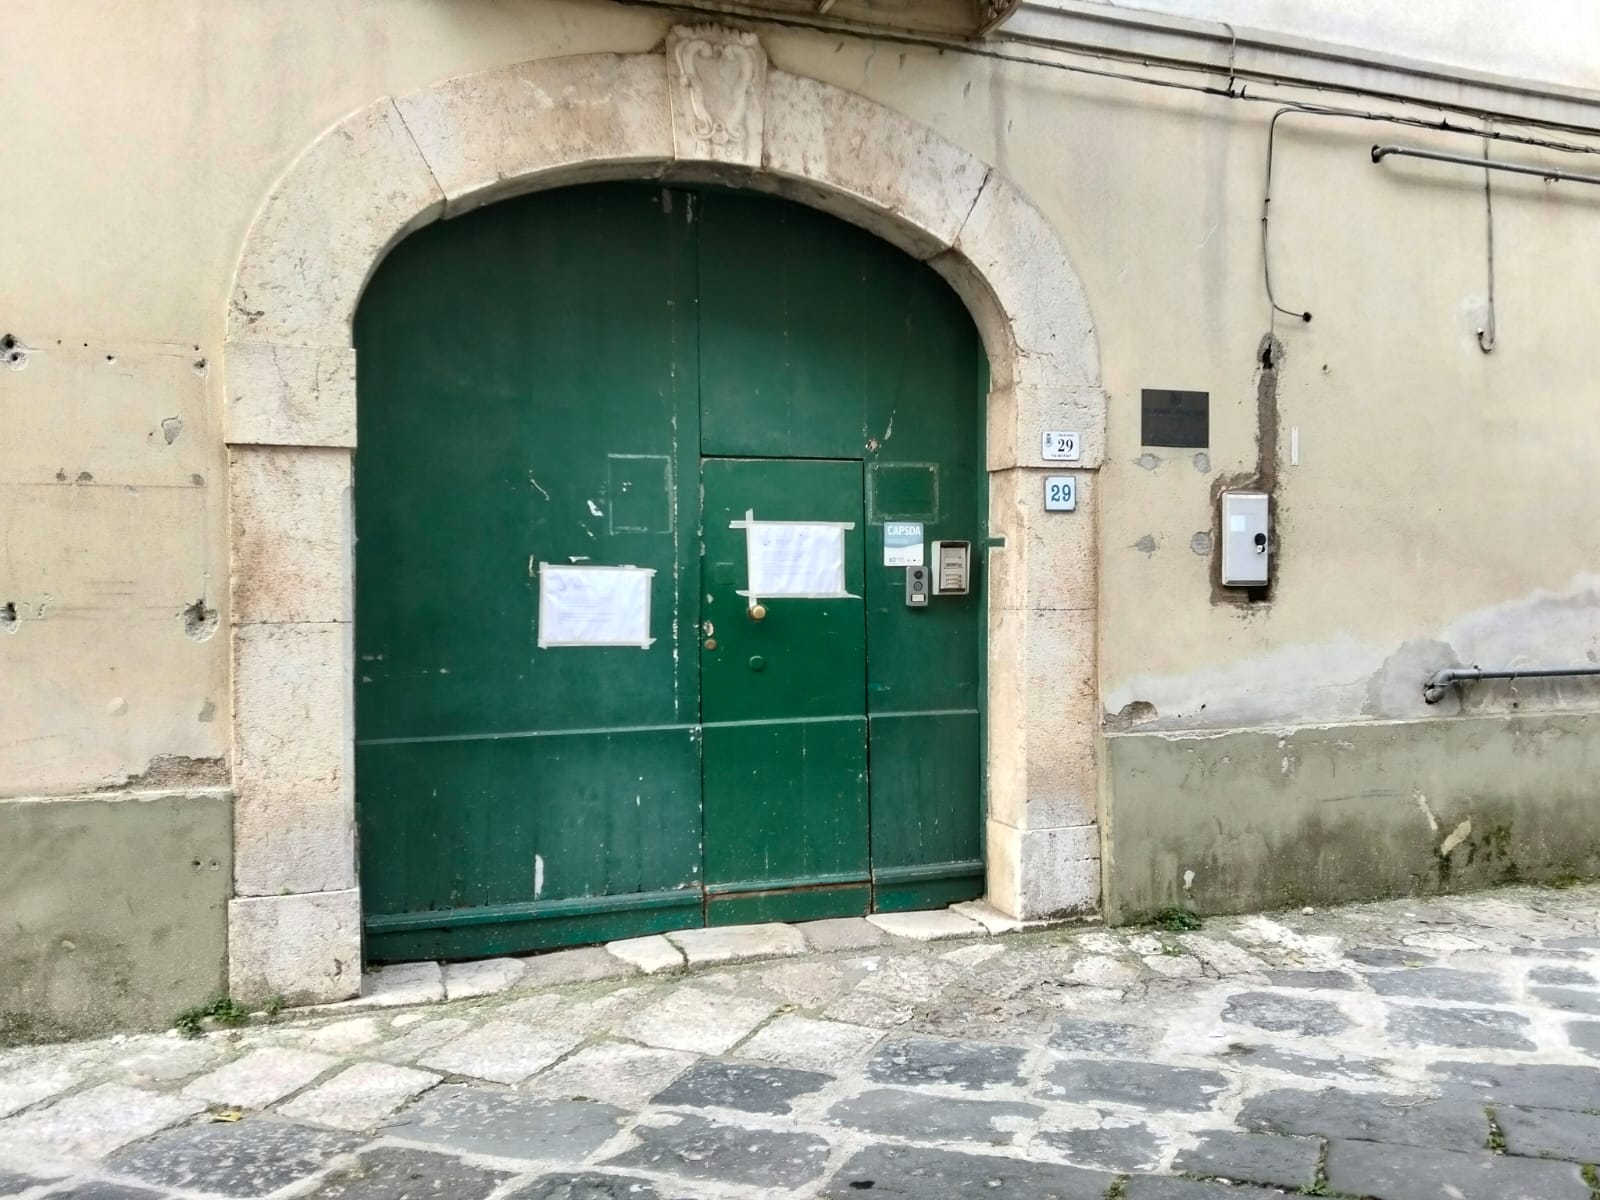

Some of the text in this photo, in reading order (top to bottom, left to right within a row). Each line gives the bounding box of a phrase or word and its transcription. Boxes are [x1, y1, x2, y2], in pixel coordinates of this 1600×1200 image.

[1057, 438, 1074, 453] 29
[1051, 484, 1071, 502] 29
[887, 525, 921, 536] CAPSDA
